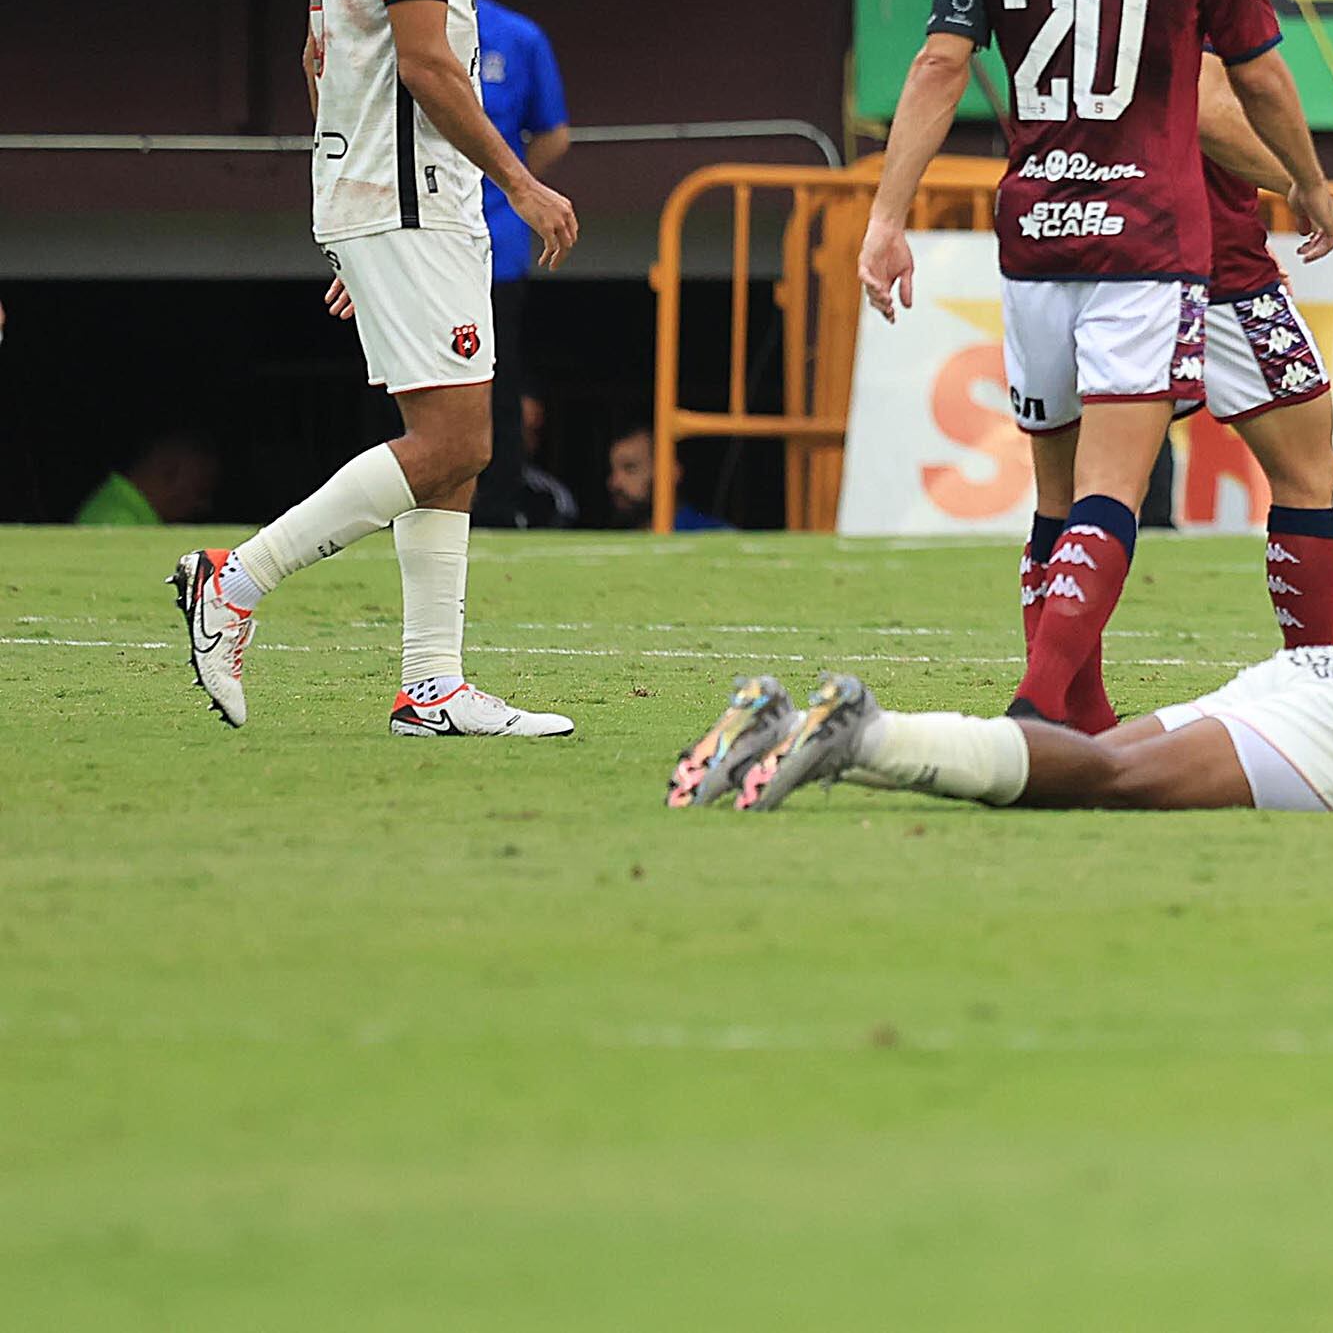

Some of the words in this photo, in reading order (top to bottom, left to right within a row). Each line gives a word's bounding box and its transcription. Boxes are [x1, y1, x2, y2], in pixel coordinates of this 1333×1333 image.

[1064, 152, 1147, 182] Pinos
[1032, 201, 1109, 221] STAR
[1042, 216, 1125, 237] CARS
